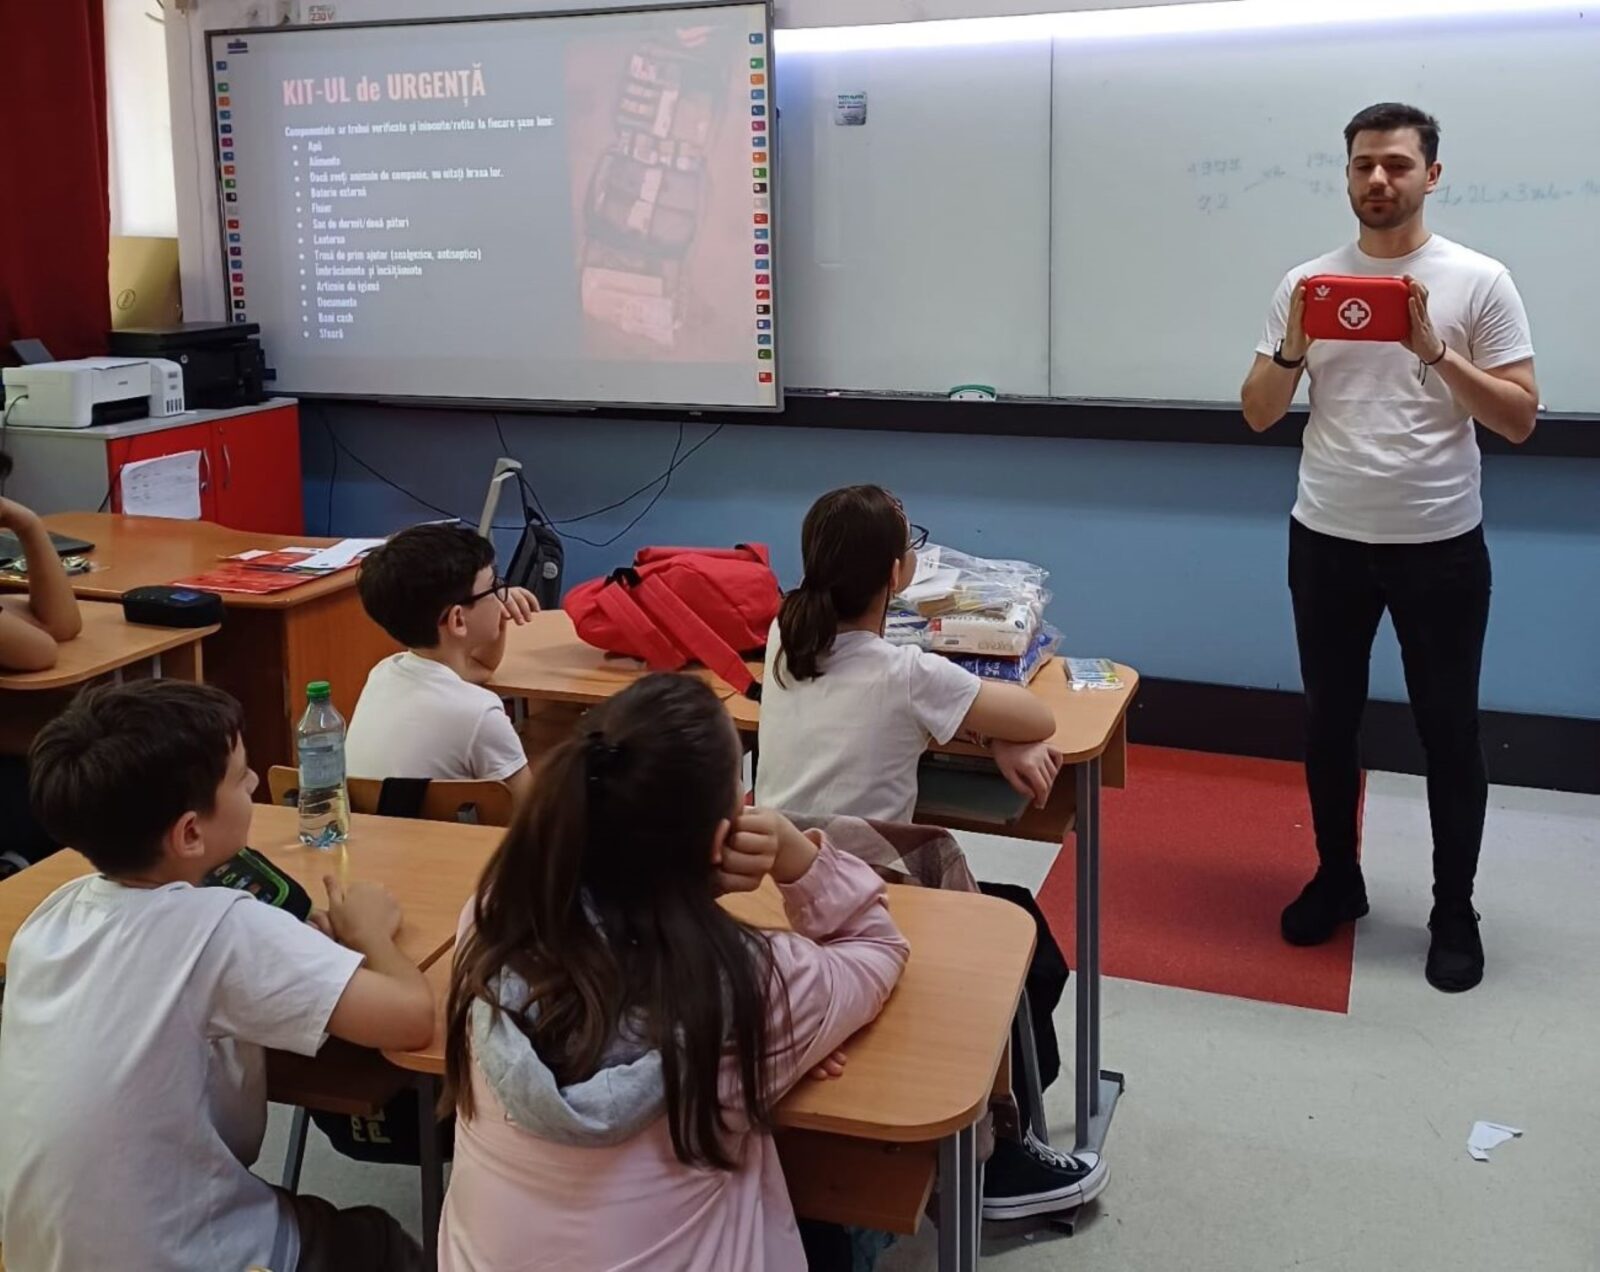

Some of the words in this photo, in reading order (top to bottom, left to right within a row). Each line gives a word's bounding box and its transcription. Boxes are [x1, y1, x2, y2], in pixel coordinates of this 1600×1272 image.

[282, 77, 350, 106] KIT-UL
[356, 76, 381, 101] de
[387, 62, 485, 107] URGENȚĂ
[336, 312, 354, 323] cash
